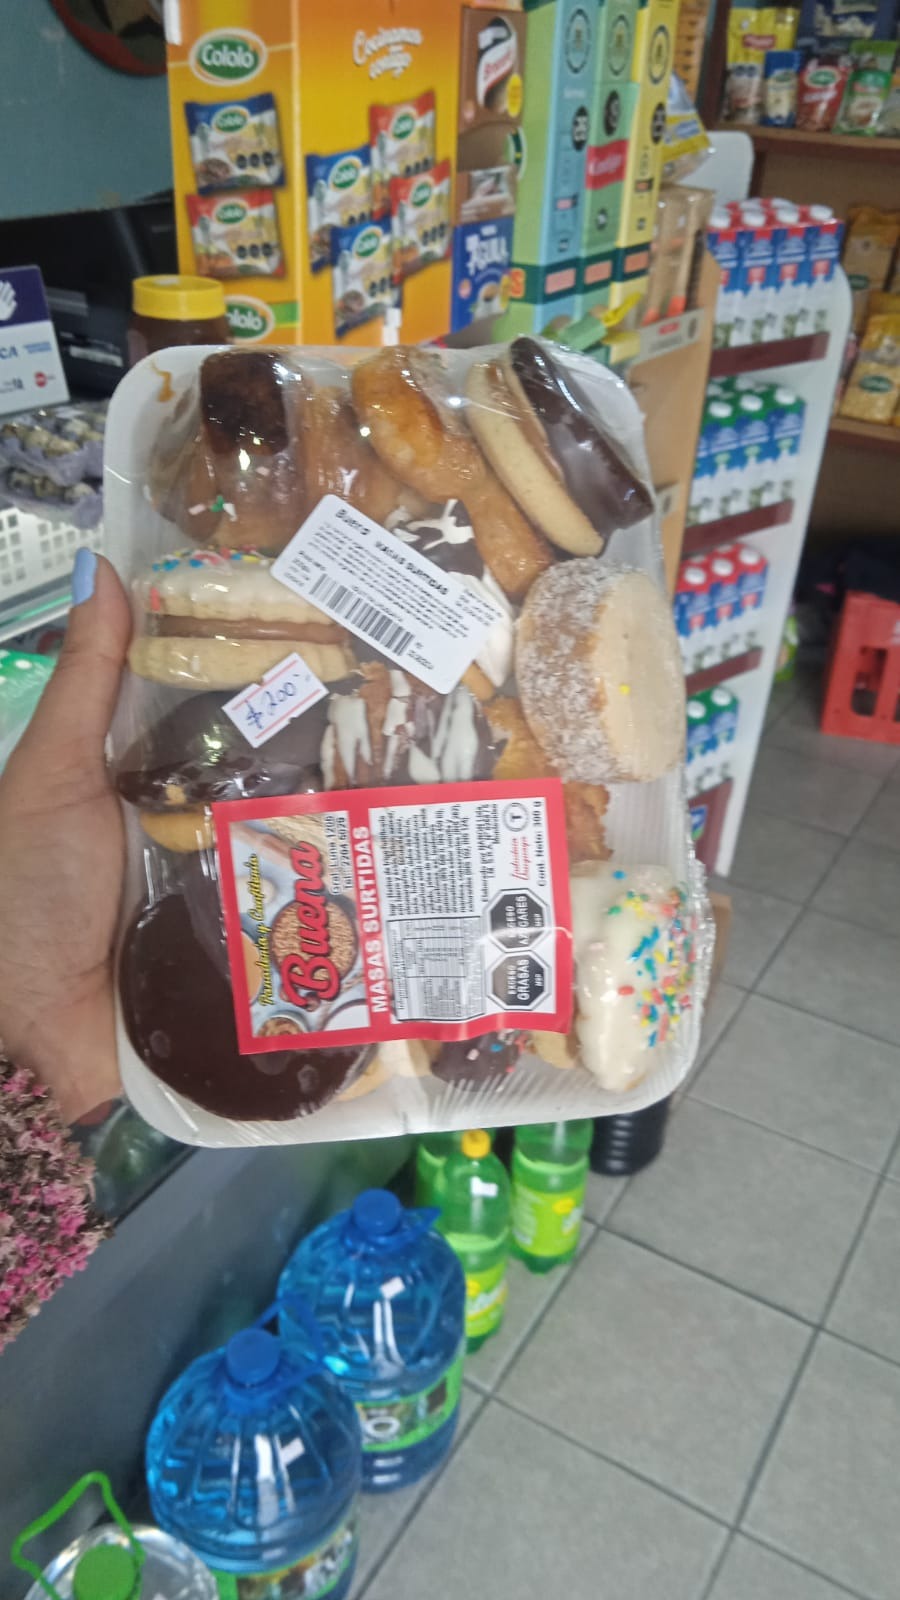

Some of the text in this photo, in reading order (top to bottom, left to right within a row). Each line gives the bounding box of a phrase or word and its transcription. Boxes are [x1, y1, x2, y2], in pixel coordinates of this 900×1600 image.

[200, 46, 256, 70] Cololo
[532, 810, 541, 826] 300
[326, 841, 339, 868] Luna
[338, 843, 350, 866] 2204
[280, 840, 341, 1009] Buena
[353, 825, 387, 1013] MASAS SURTIDAS
[516, 959, 530, 1001] GRASAS
